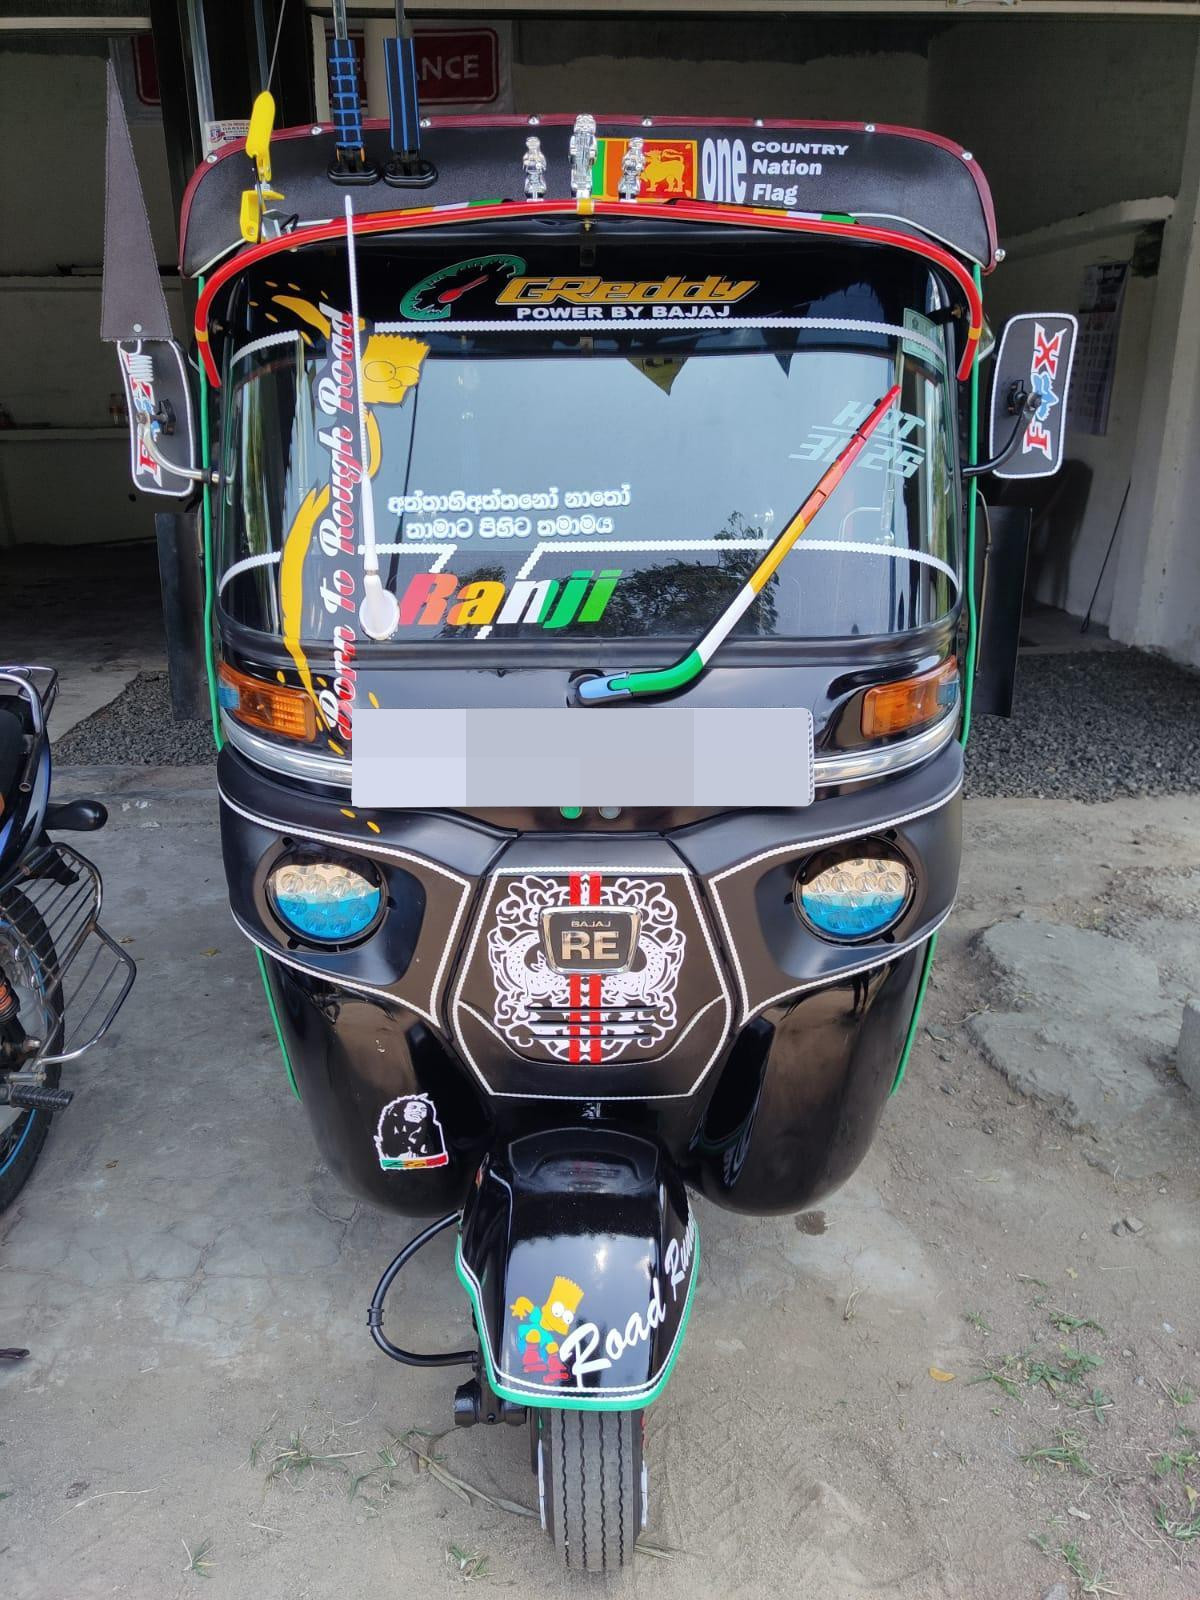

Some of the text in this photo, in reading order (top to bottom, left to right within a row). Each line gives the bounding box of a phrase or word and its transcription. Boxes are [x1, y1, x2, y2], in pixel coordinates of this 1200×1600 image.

[417, 54, 481, 82] NCE
[751, 141, 849, 155] COUNTRY
[702, 137, 747, 203] one
[752, 158, 822, 176] Nation
[752, 183, 798, 205] Flag
[516, 305, 730, 319] POWER BY BAJAJ
[318, 302, 363, 740] Born to Rough Road
[399, 569, 623, 628] Ranji
[571, 920, 611, 928] BAJAJ
[561, 930, 620, 960] RE
[559, 1277, 666, 1389] Road
